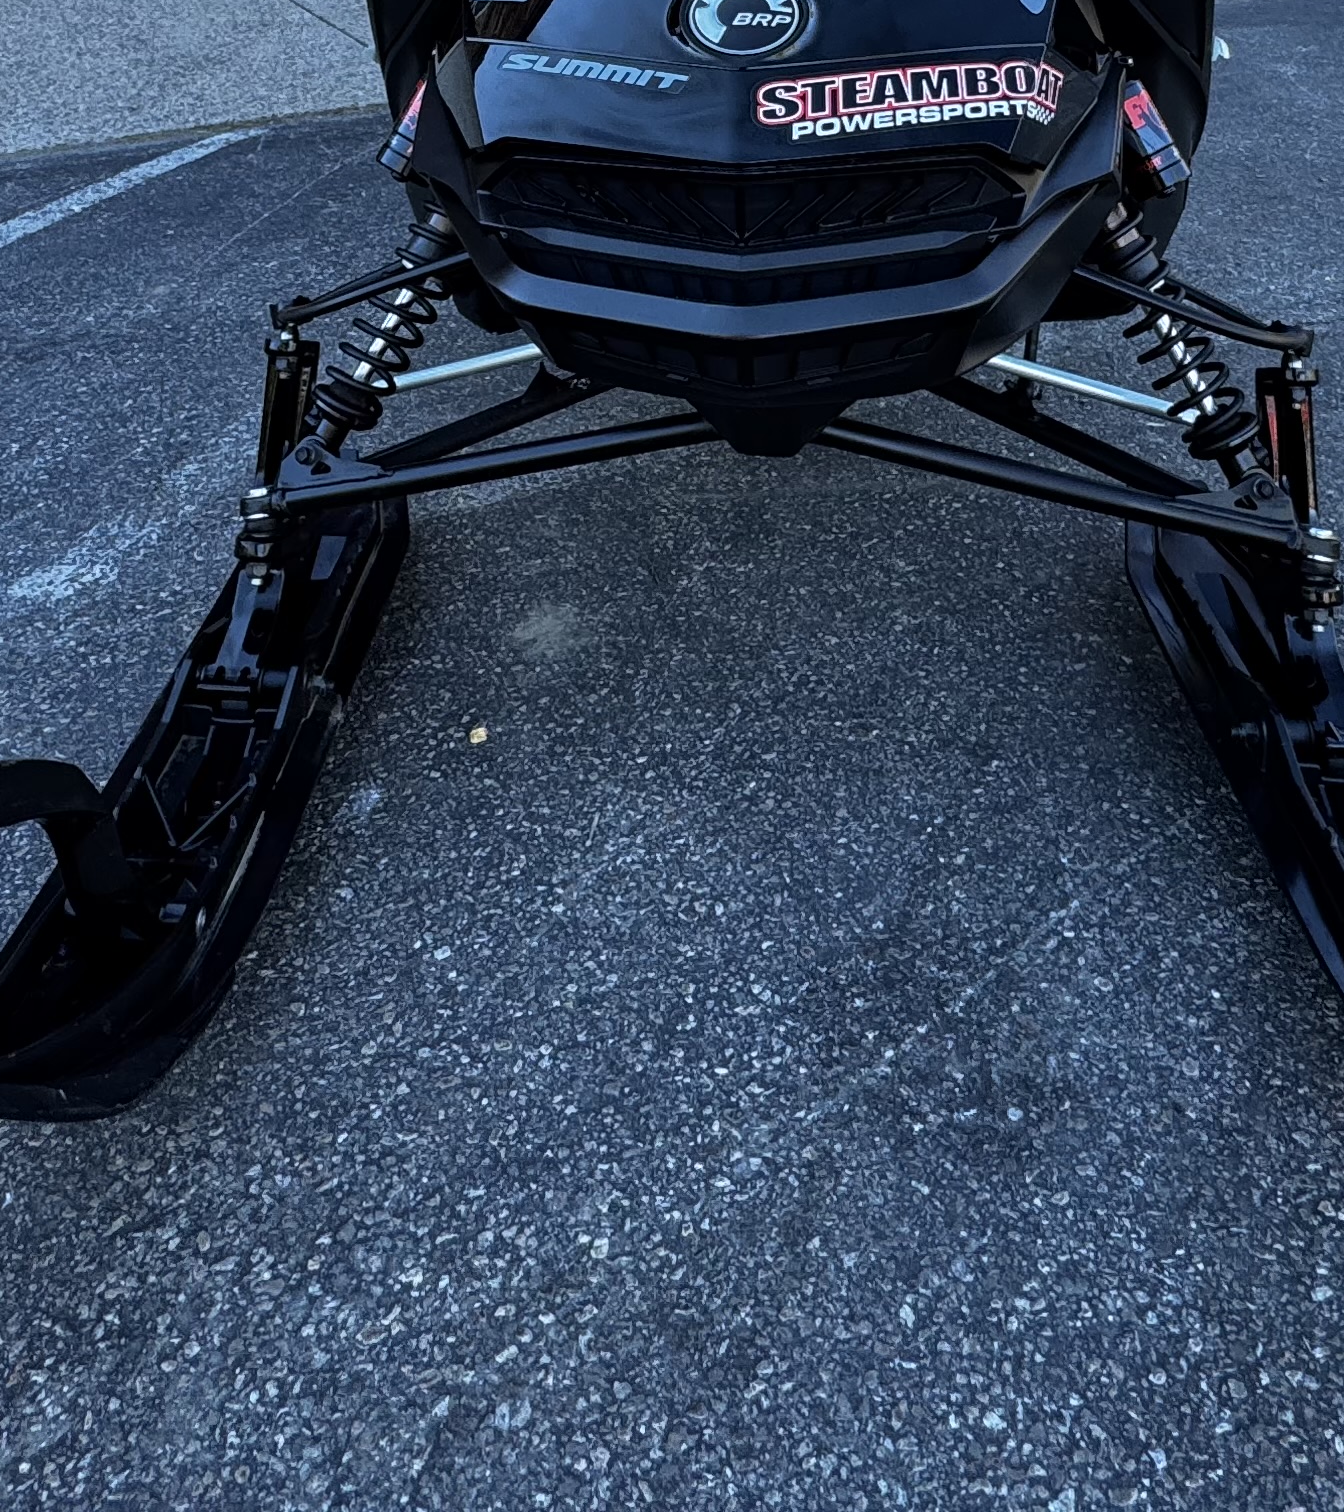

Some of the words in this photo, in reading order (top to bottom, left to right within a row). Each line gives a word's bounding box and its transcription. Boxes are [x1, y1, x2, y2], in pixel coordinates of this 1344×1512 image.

[731, 11, 793, 28] BRP
[502, 52, 690, 90] SUMMIT
[756, 60, 1064, 127] STEAMBOAT
[791, 98, 1038, 141] POWERSPORTS
